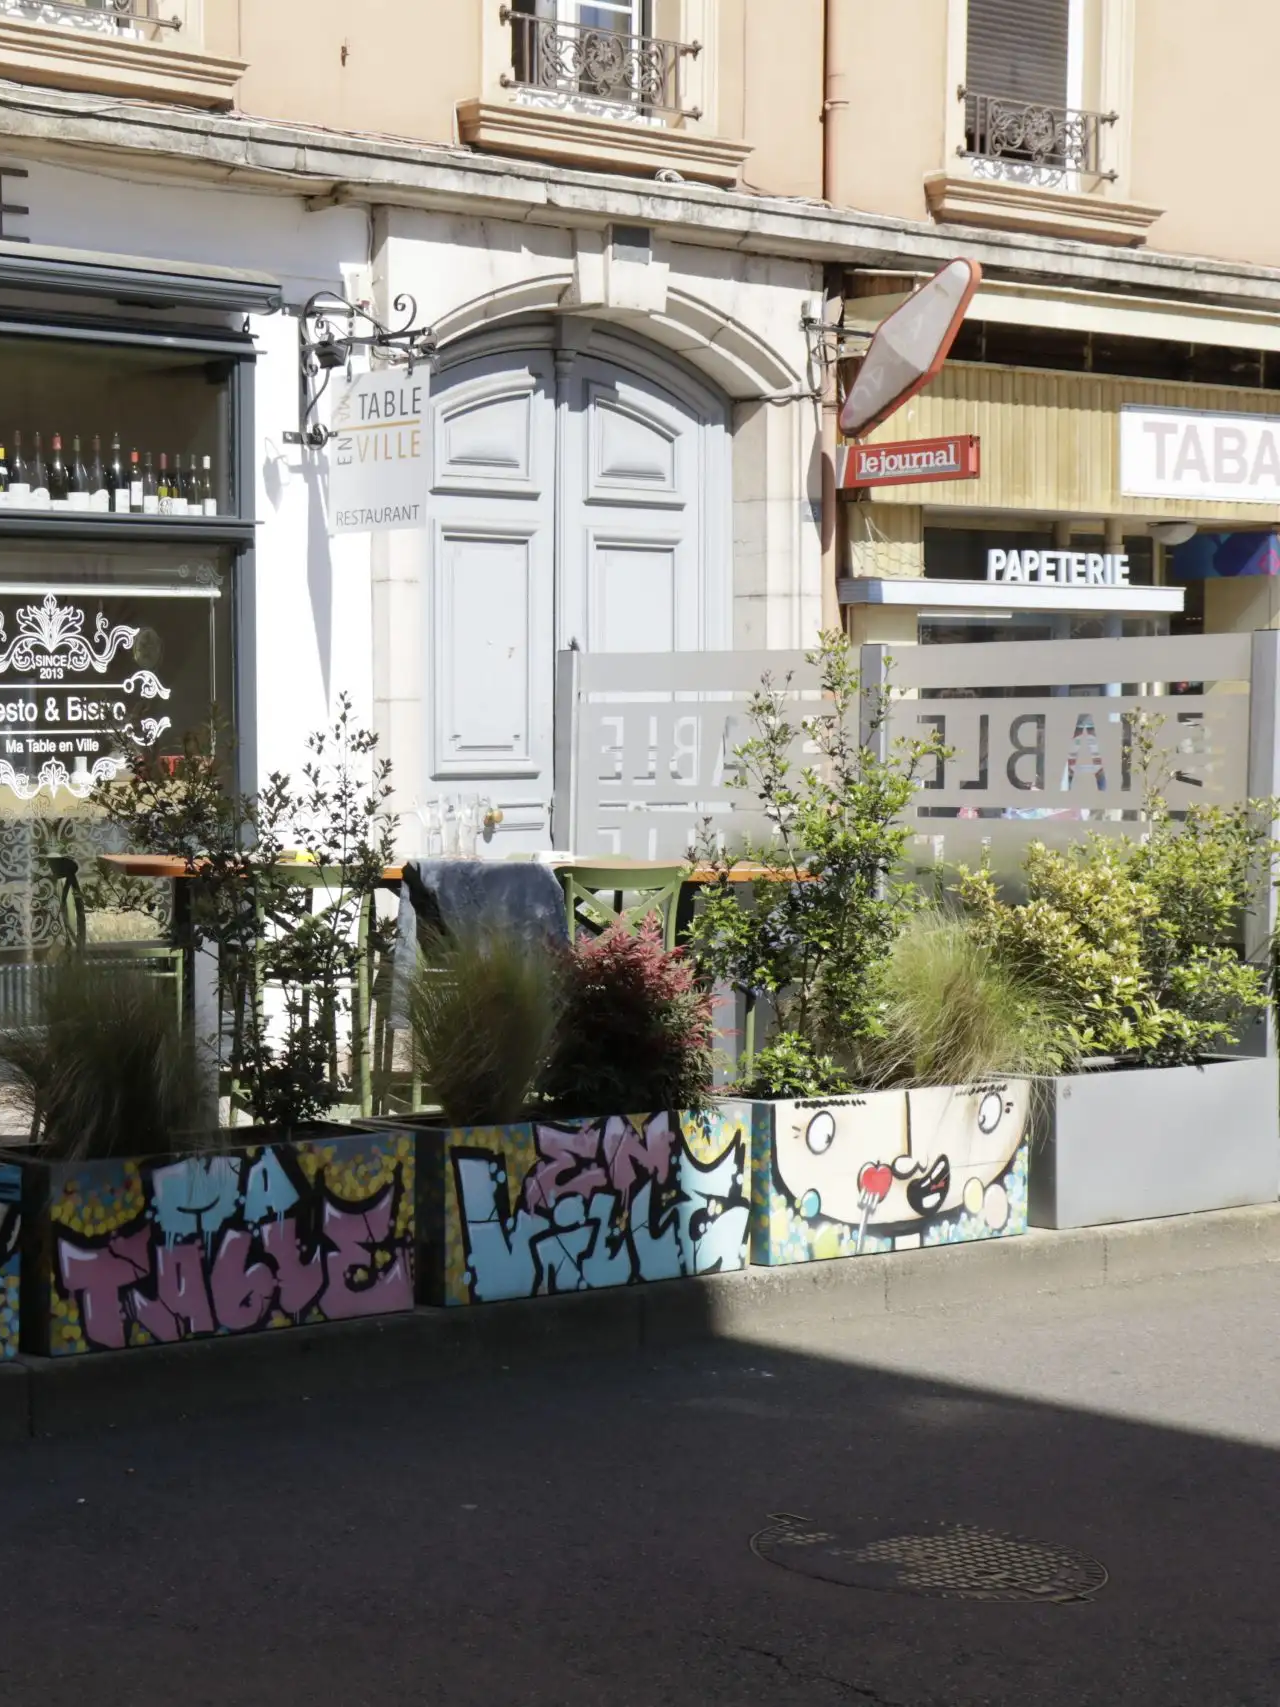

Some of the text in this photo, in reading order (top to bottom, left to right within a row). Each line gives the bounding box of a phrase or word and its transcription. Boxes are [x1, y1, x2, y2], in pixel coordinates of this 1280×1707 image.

[358, 386, 422, 420] TABLE
[337, 437, 353, 465] EN
[357, 430, 421, 462] VILLE
[1142, 421, 1280, 487] TABA
[336, 504, 420, 526] RESTAURANT
[987, 548, 1130, 586] PAPETERIE
[35, 654, 67, 668] SINCE
[39, 667, 64, 680] 2013
[44, 696, 60, 722] &
[6, 738, 99, 753] Ma Table en Ville
